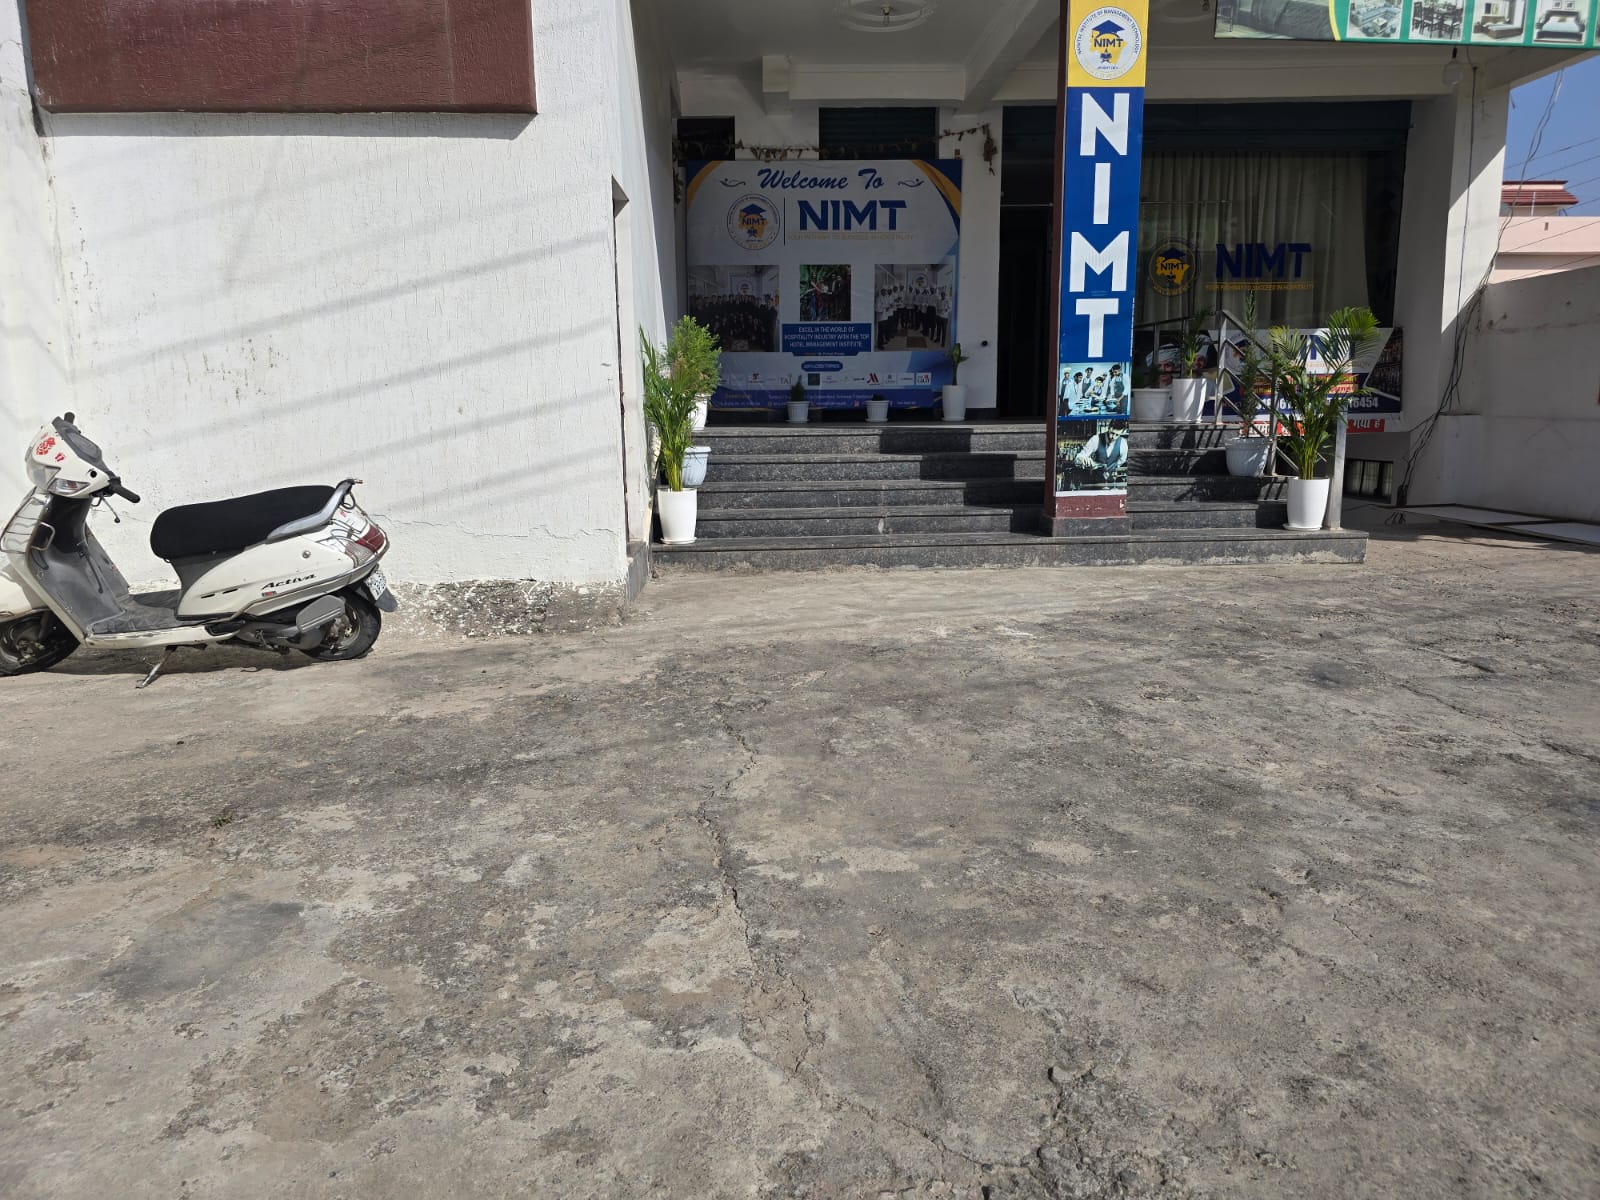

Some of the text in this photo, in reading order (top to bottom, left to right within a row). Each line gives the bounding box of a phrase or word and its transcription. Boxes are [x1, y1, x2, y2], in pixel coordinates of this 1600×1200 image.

[1094, 38, 1124, 47] NIMT
[757, 168, 885, 190] Welcome To
[741, 217, 767, 226] NIMT
[797, 200, 907, 231] NIMT
[1160, 262, 1186, 271] NIMT
[1216, 243, 1312, 278] NIMT
[260, 574, 317, 590] Activa
